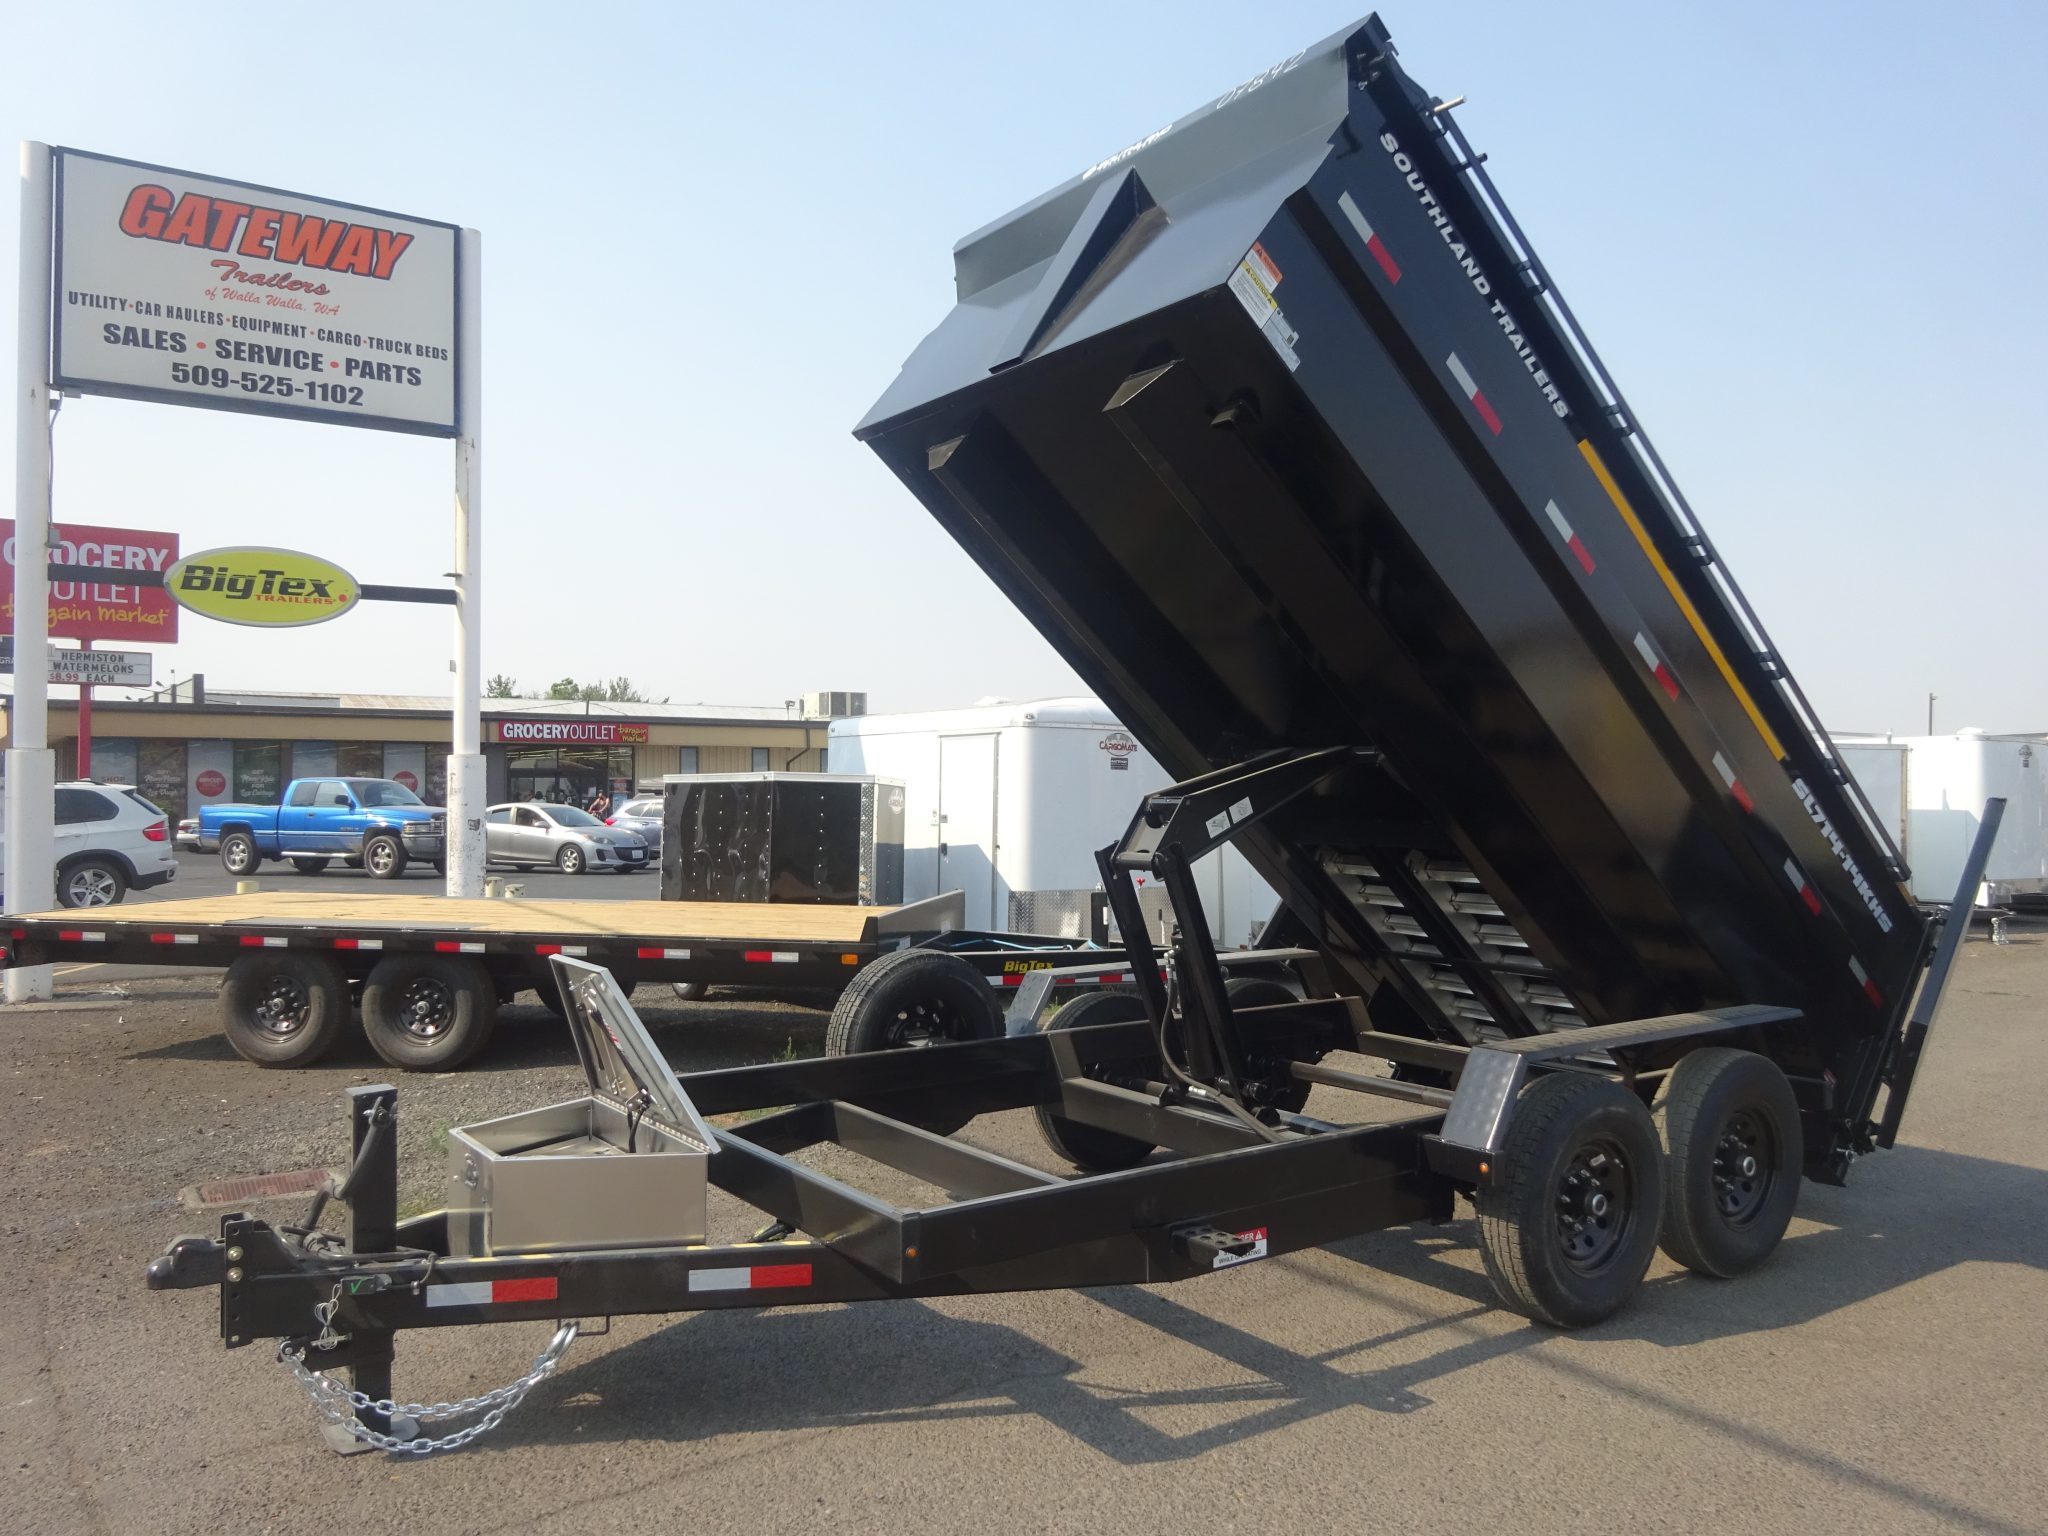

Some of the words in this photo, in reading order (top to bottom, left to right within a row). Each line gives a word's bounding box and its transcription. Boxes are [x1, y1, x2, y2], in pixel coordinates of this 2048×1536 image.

[118, 183, 415, 281] GATEWAY
[210, 259, 331, 295] Trailers
[1379, 132, 1492, 296] SOUTHLAND
[1490, 298, 1570, 419] TRAILERS
[204, 286, 218, 301] of
[222, 287, 261, 304] Walla
[313, 302, 341, 316] WA
[68, 291, 128, 312] UTILITY
[135, 301, 161, 317] CAR
[166, 305, 224, 326] HAULERS
[232, 315, 307, 339] EQUIPMENT
[318, 328, 362, 347] CARGO
[368, 336, 412, 355] TRUCK
[416, 344, 448, 361] BEDS
[103, 322, 187, 353] SALES
[215, 338, 324, 373] SERVICE
[345, 357, 422, 387] PARTS
[171, 361, 364, 406] 509-525-1102
[180, 564, 334, 600] BigTex
[98, 605, 169, 626] market
[255, 594, 333, 605] TRAILERS
[52, 661, 134, 674] WATERMELONS
[61, 652, 125, 663] HERMISTON
[86, 674, 115, 683] EACH
[1004, 960, 1054, 974] BigTex
